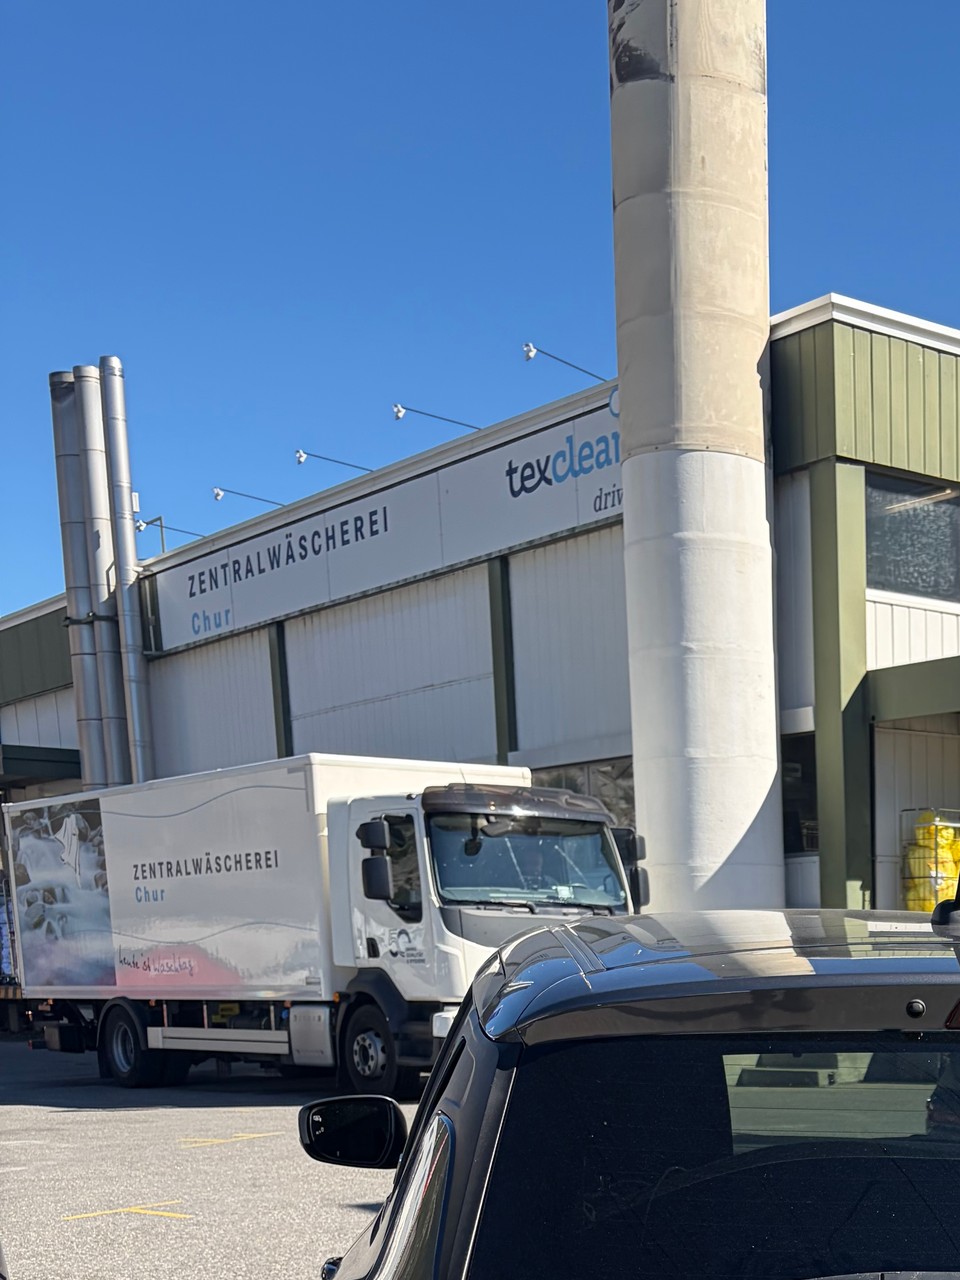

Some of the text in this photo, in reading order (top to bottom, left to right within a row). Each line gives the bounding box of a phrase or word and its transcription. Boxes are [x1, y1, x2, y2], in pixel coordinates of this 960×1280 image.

[187, 506, 389, 598] ZENTRALWÄSCHEREI
[191, 608, 231, 635] Chur
[133, 850, 279, 881] ZENTRALWÄSCHEREI
[135, 886, 165, 903] Chur
